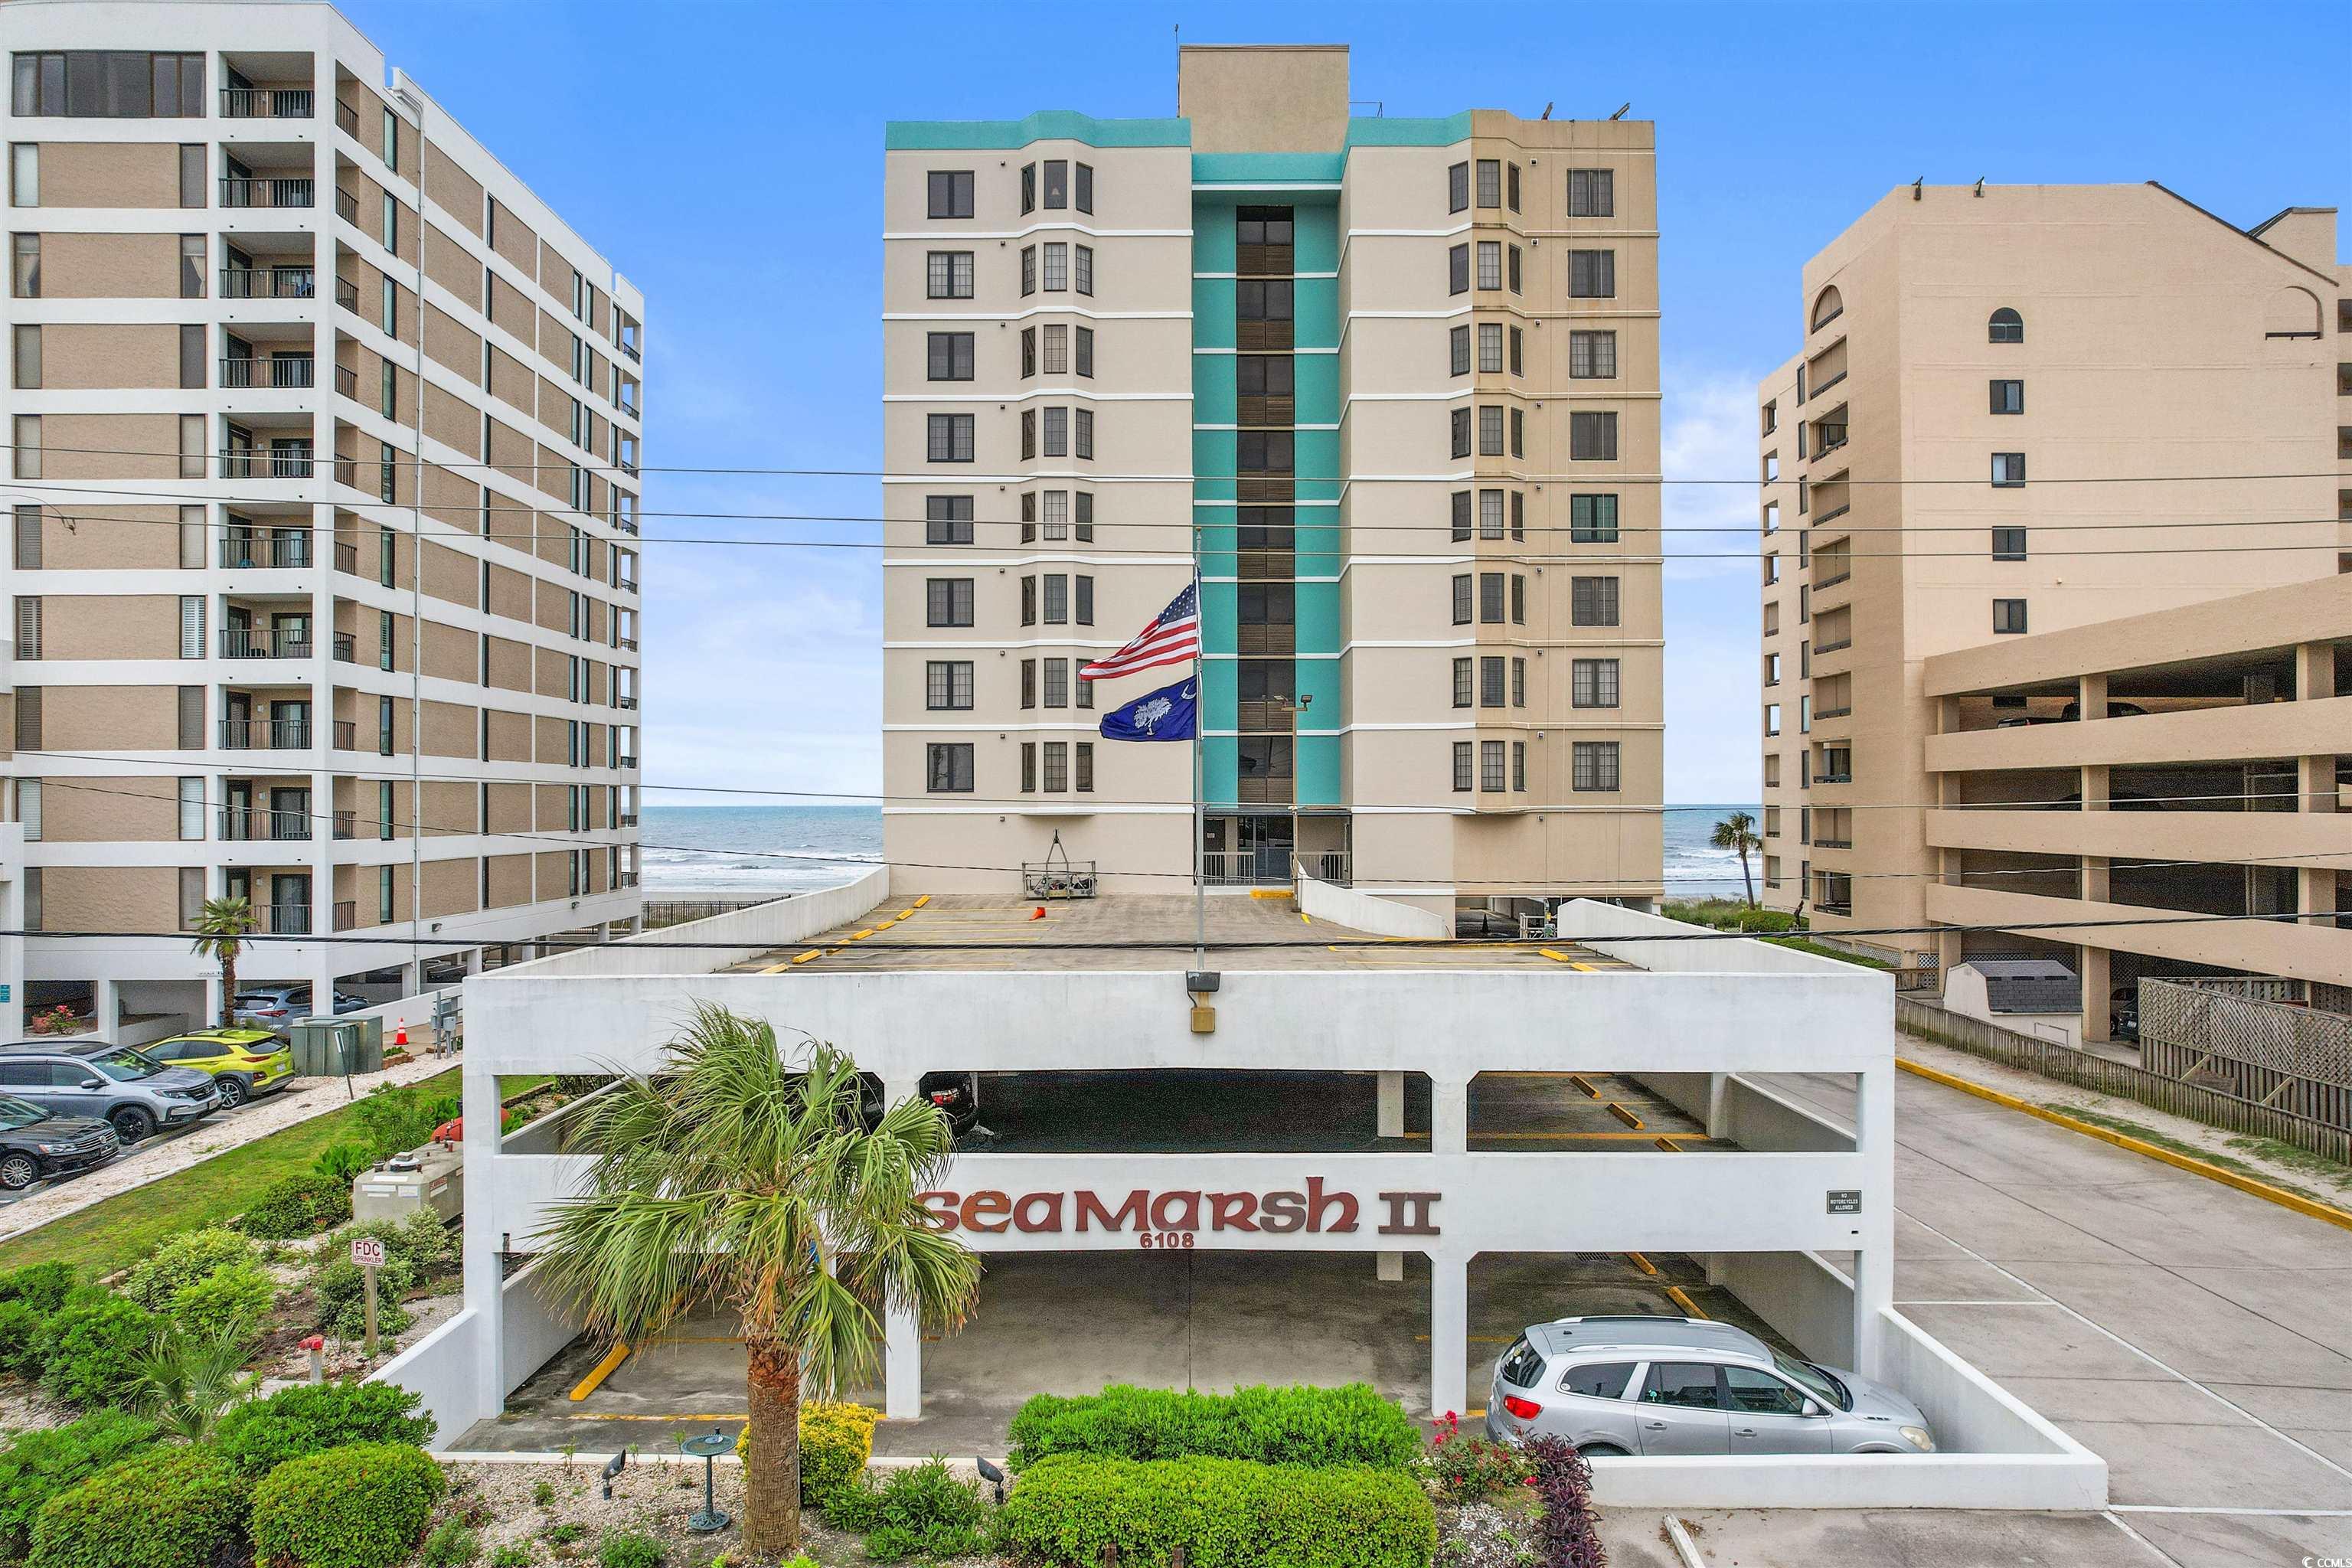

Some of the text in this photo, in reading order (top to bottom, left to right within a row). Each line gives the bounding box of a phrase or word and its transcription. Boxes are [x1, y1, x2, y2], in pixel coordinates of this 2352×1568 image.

[1378, 1192, 1442, 1235] II
[1140, 1232, 1194, 1249] 6108
[355, 1242, 381, 1256] FDC
[354, 1255, 382, 1264] SPRINKLER
